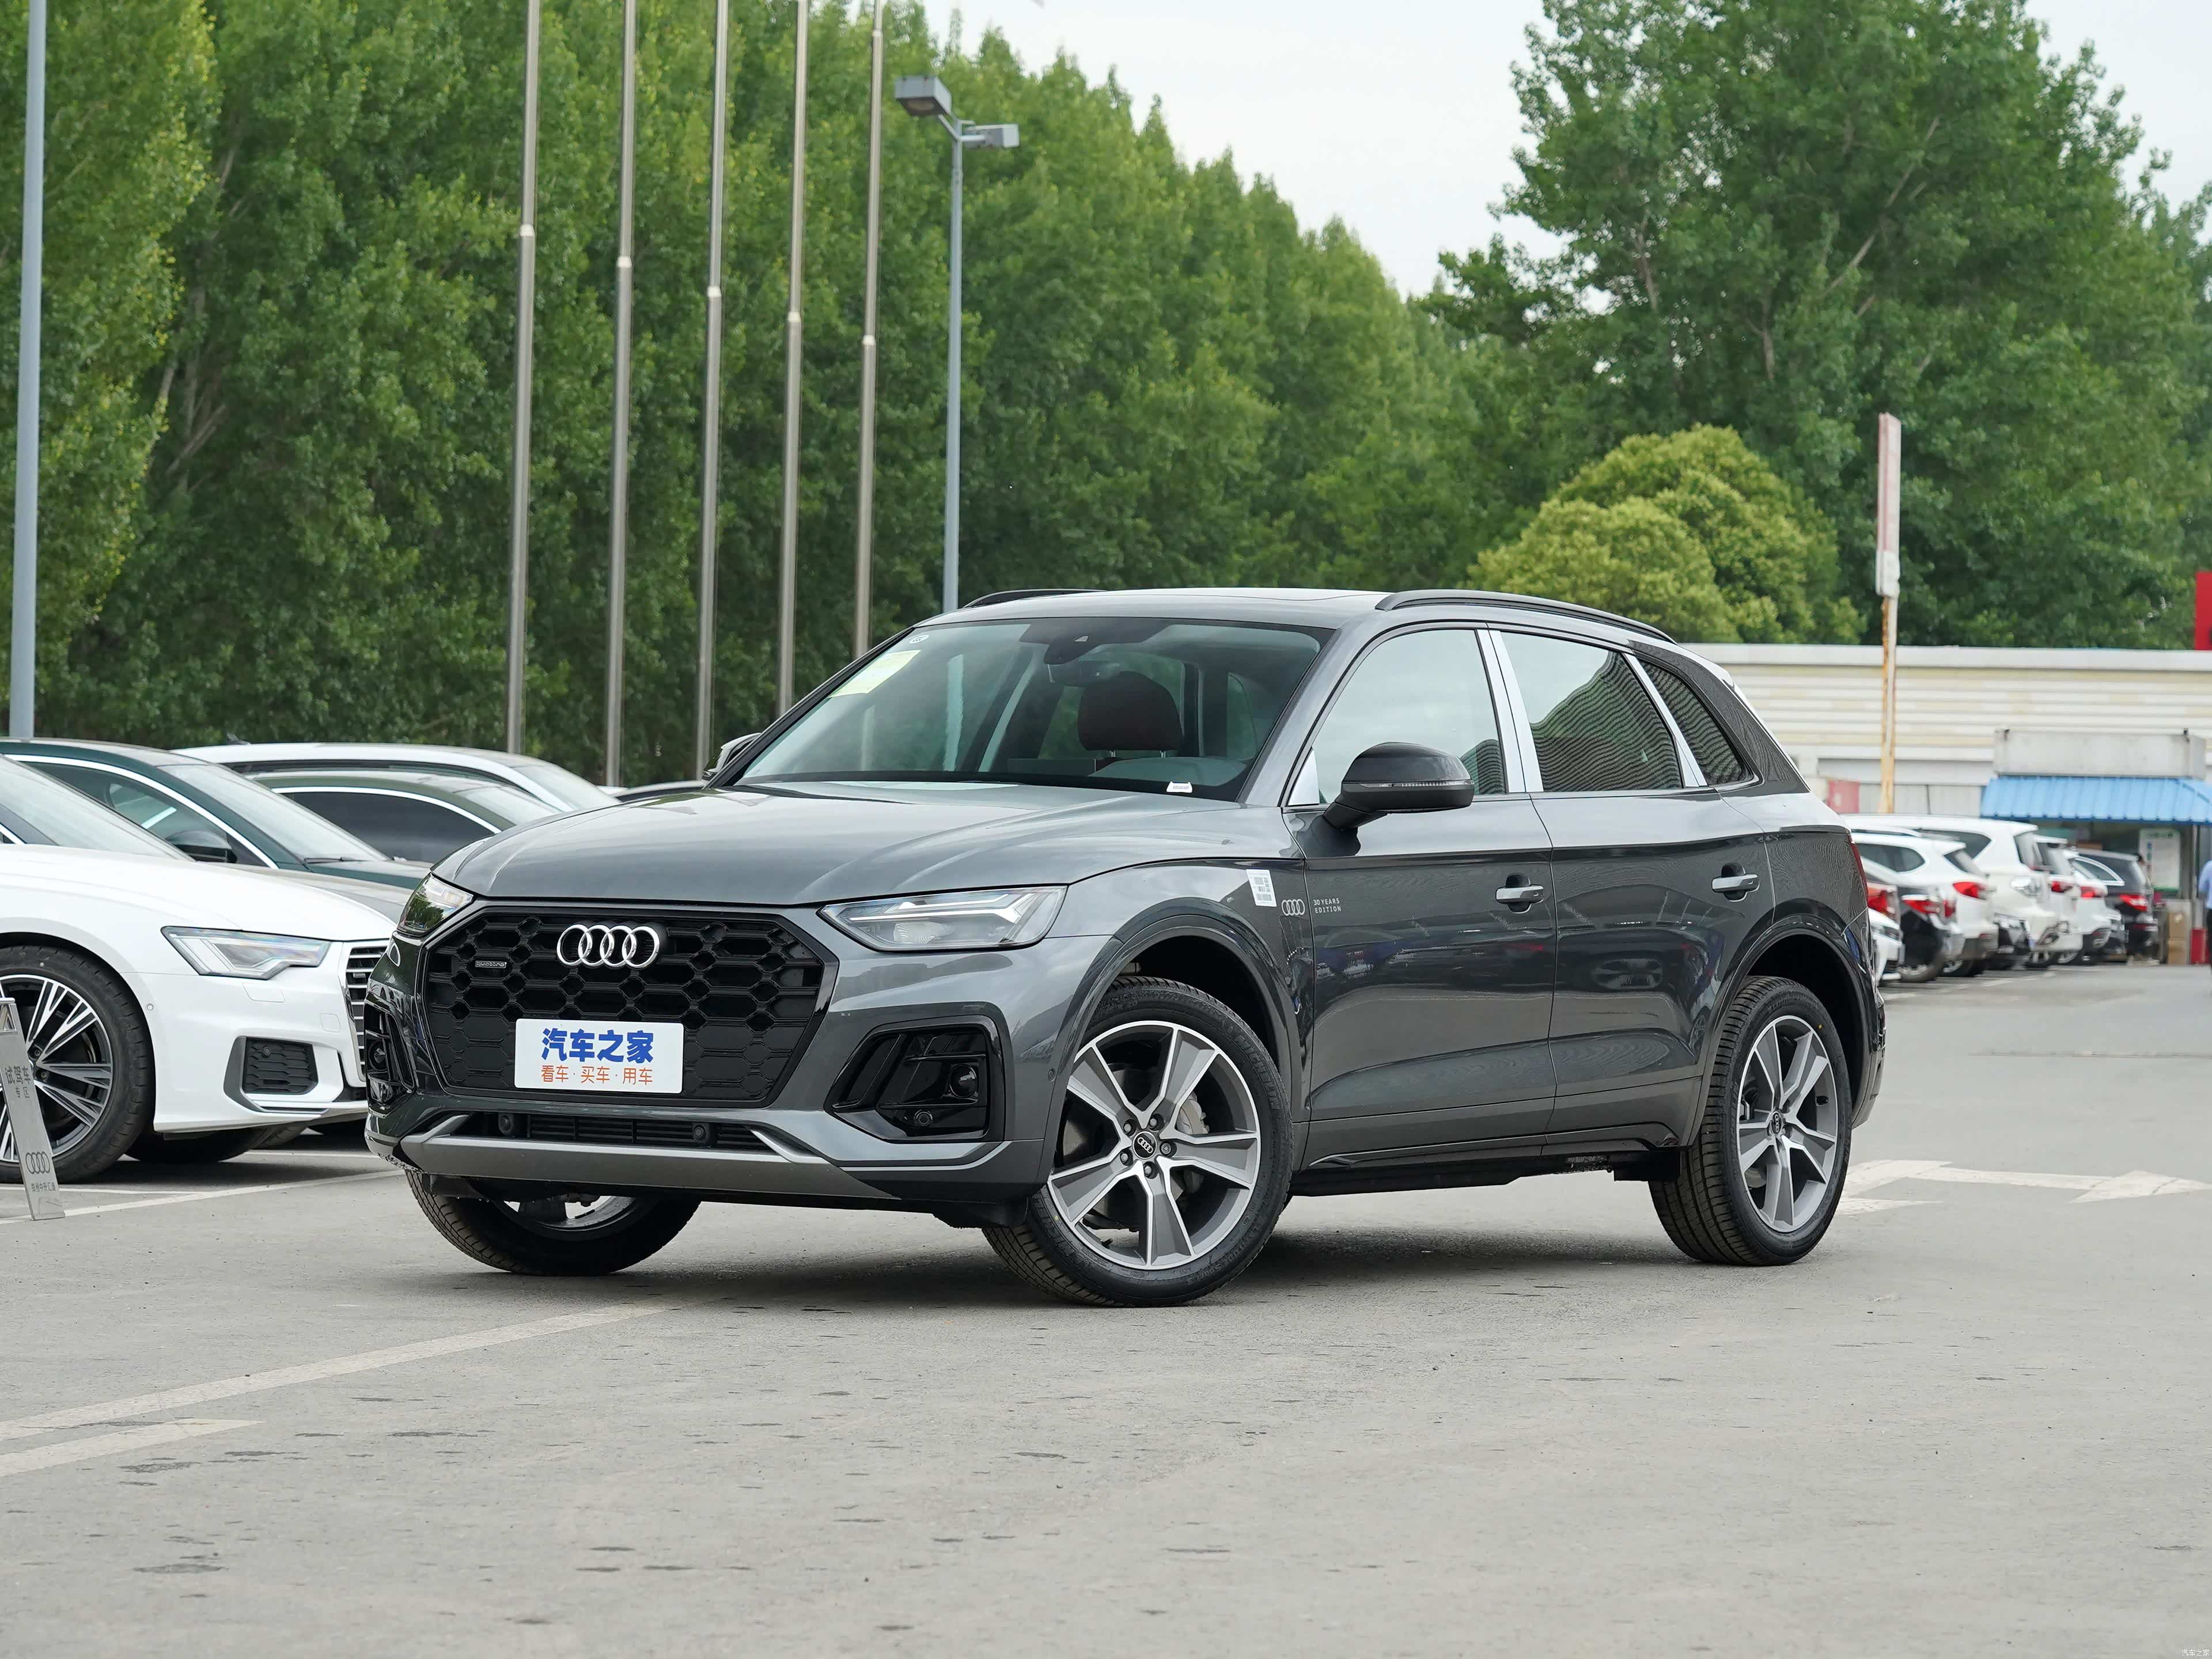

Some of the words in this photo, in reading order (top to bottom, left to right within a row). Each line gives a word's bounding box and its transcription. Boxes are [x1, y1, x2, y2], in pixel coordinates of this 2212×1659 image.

[1315, 906, 1342, 914] EDITION
[541, 1028, 654, 1064] 汽车之家
[5, 1065, 31, 1085] 试驾车
